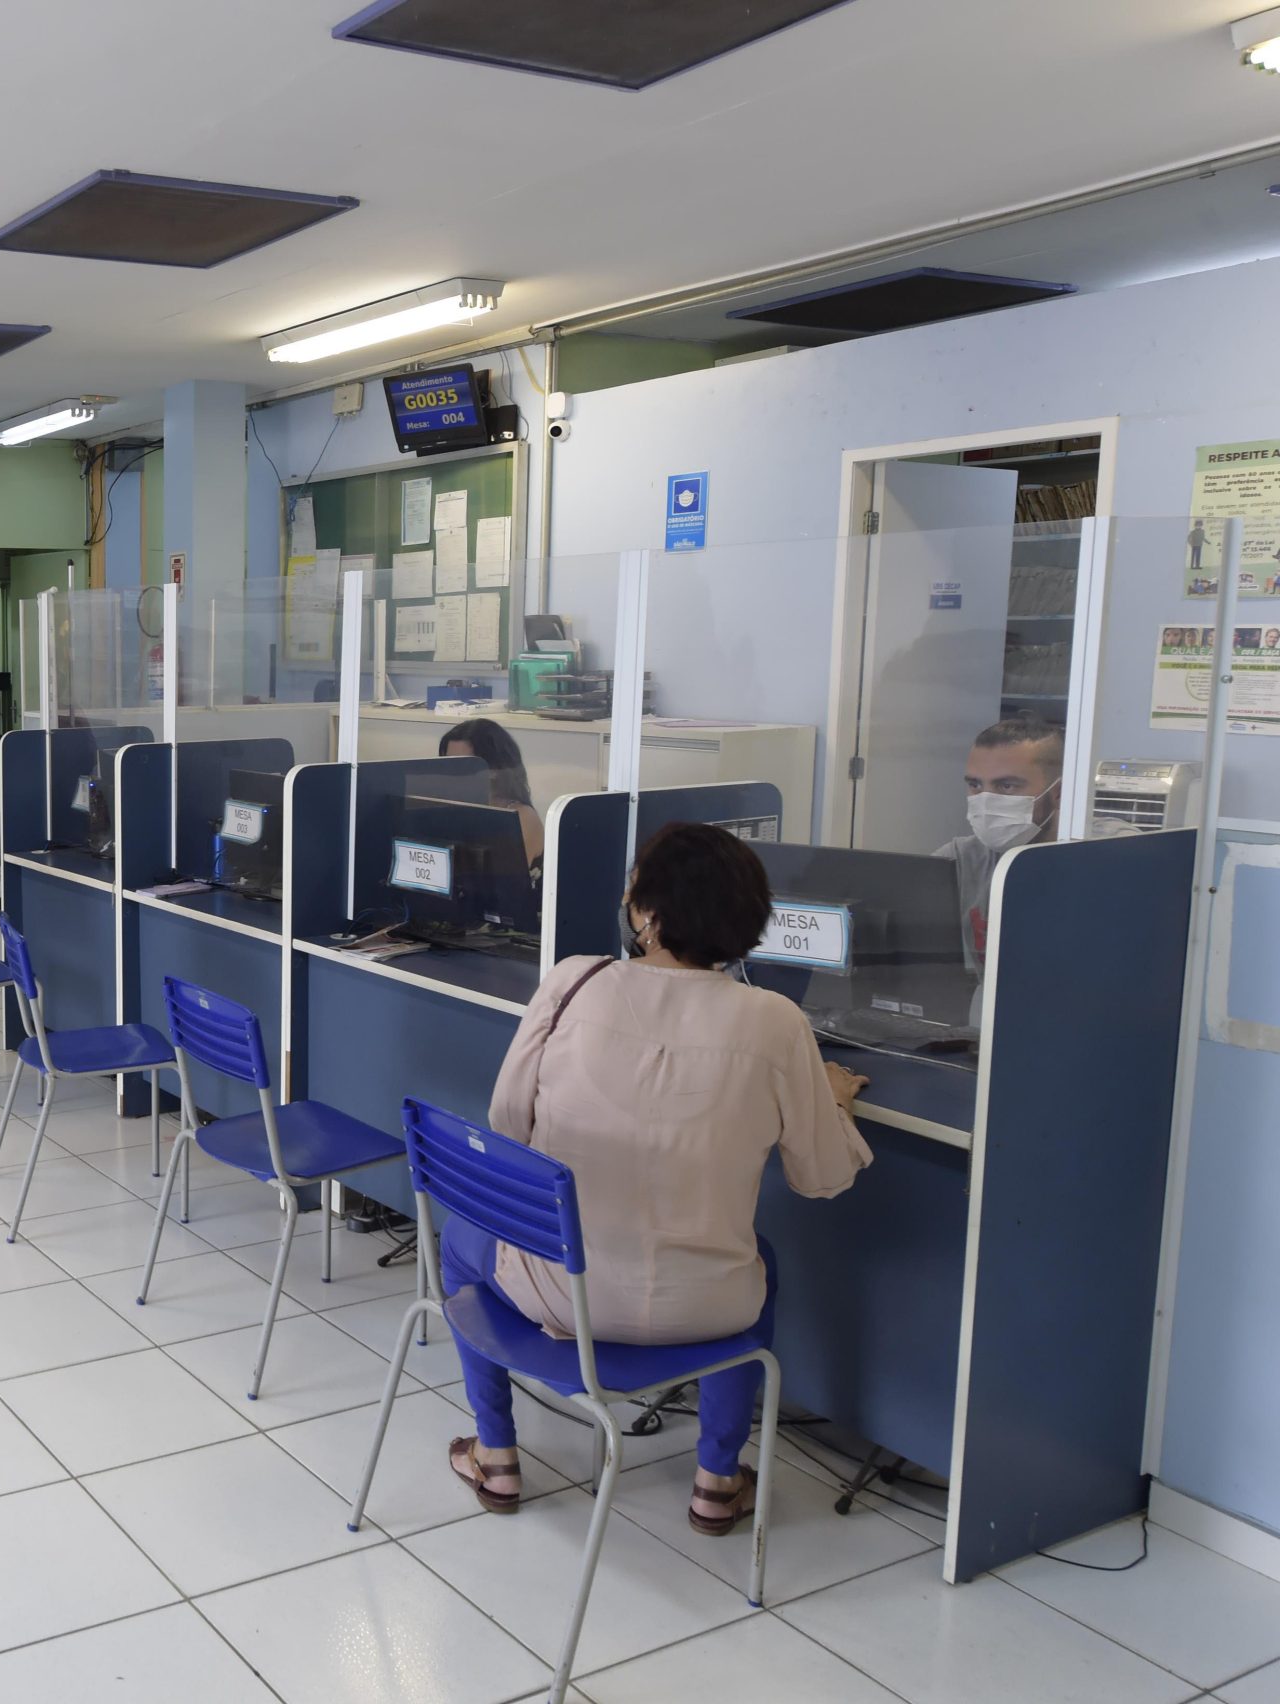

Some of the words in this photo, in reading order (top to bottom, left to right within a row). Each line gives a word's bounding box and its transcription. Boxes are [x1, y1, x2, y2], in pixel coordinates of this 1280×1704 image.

[402, 376, 453, 390] Atendimento
[404, 388, 459, 410] G0035
[406, 421, 430, 430] Mesa:
[441, 411, 465, 425] 004
[1208, 449, 1269, 463] RESPEITE
[234, 808, 253, 821] MESA
[409, 850, 436, 865] MESA
[415, 867, 431, 880] 002
[773, 913, 820, 931] MESA
[783, 934, 809, 951] 001
